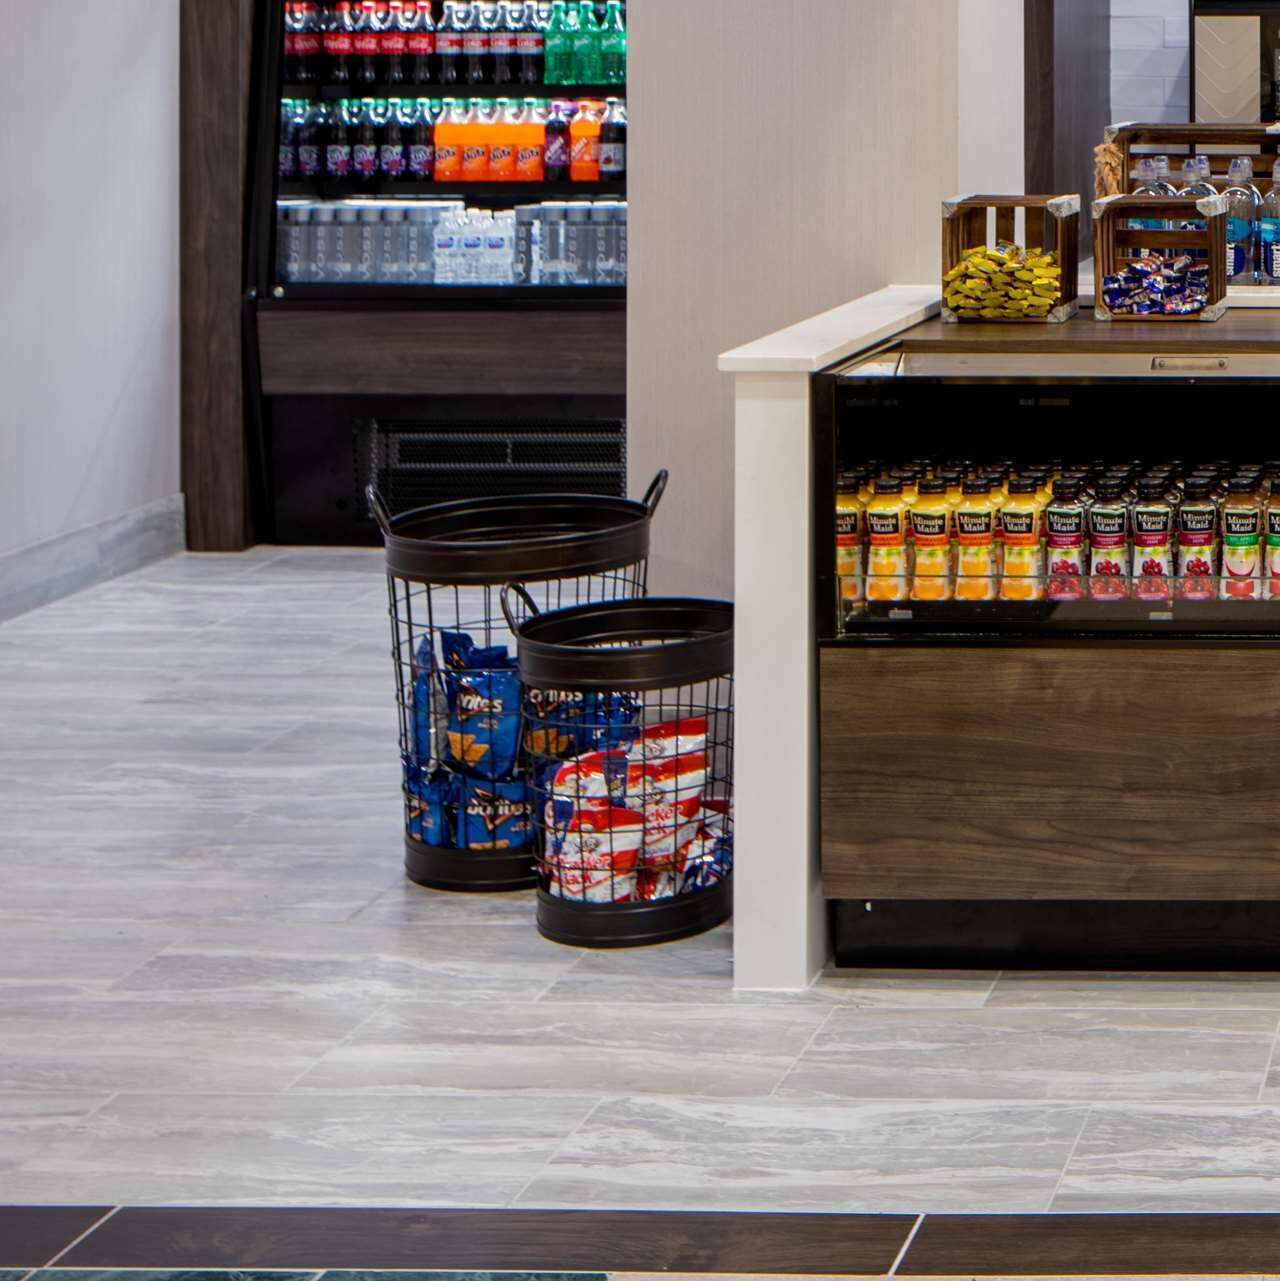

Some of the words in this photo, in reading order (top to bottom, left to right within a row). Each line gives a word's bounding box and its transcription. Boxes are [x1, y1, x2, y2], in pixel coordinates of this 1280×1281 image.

[1226, 242, 1235, 276] smart
[870, 516, 897, 524] Minute
[914, 516, 943, 525] Minute
[960, 516, 989, 524] Minute
[1004, 515, 1030, 524] Minute
[1050, 514, 1079, 523] Minute
[1093, 515, 1123, 524] Minute
[1138, 514, 1168, 522] Minute
[1183, 513, 1213, 521] Minute
[1228, 516, 1256, 524] Minute
[873, 523, 894, 532] Maid
[917, 524, 941, 533] Maid
[963, 523, 986, 531] Maid
[1007, 523, 1027, 531] Maid
[1053, 523, 1077, 531] Maid
[1096, 523, 1120, 531] Maid
[1142, 521, 1163, 529] Maid
[1187, 521, 1209, 529] Maid
[1231, 523, 1252, 531] Maid
